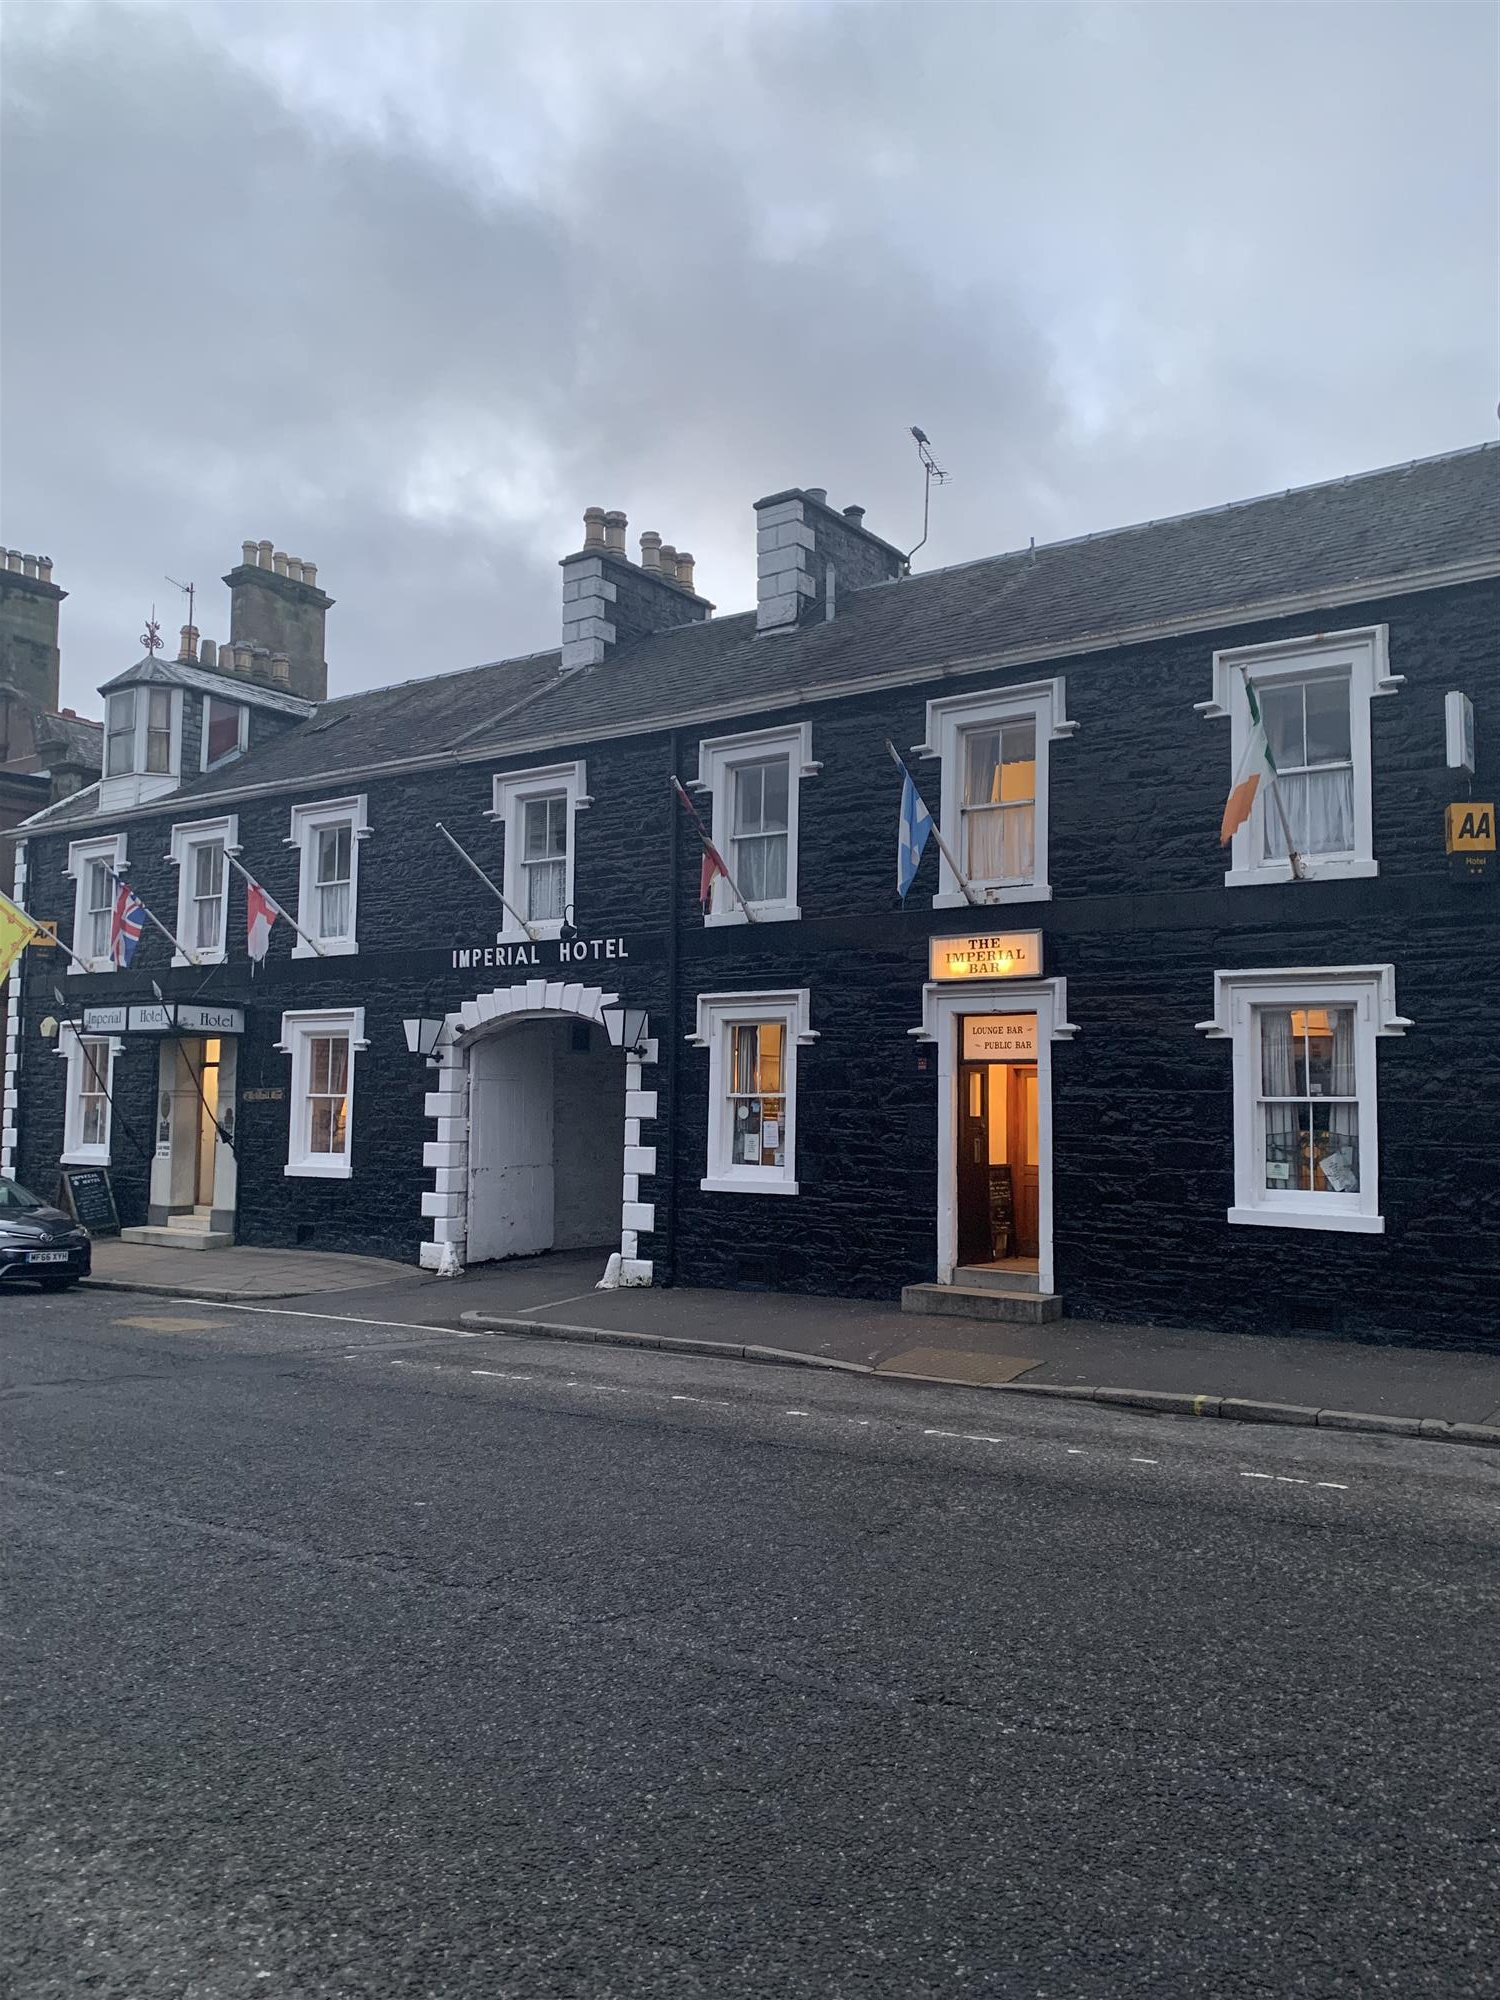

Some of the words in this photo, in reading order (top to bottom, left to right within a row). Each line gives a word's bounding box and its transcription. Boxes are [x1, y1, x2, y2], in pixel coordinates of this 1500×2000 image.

[1458, 812, 1491, 839] AA
[1466, 857, 1487, 865] Hotel
[968, 938, 1001, 950] THE
[452, 945, 541, 969] IMPERIAL
[559, 938, 629, 962] HOTEL
[945, 949, 1026, 964] IMPERIAL
[969, 962, 1000, 974] BAR
[87, 1010, 122, 1028] Imperial
[140, 1009, 163, 1023] Hotel
[200, 1012, 234, 1028] Hotel
[972, 1026, 1004, 1035] LOUNGE
[1007, 1026, 1024, 1035] BAR
[984, 1041, 1012, 1050] PUBLIC
[1015, 1041, 1032, 1050] BAR
